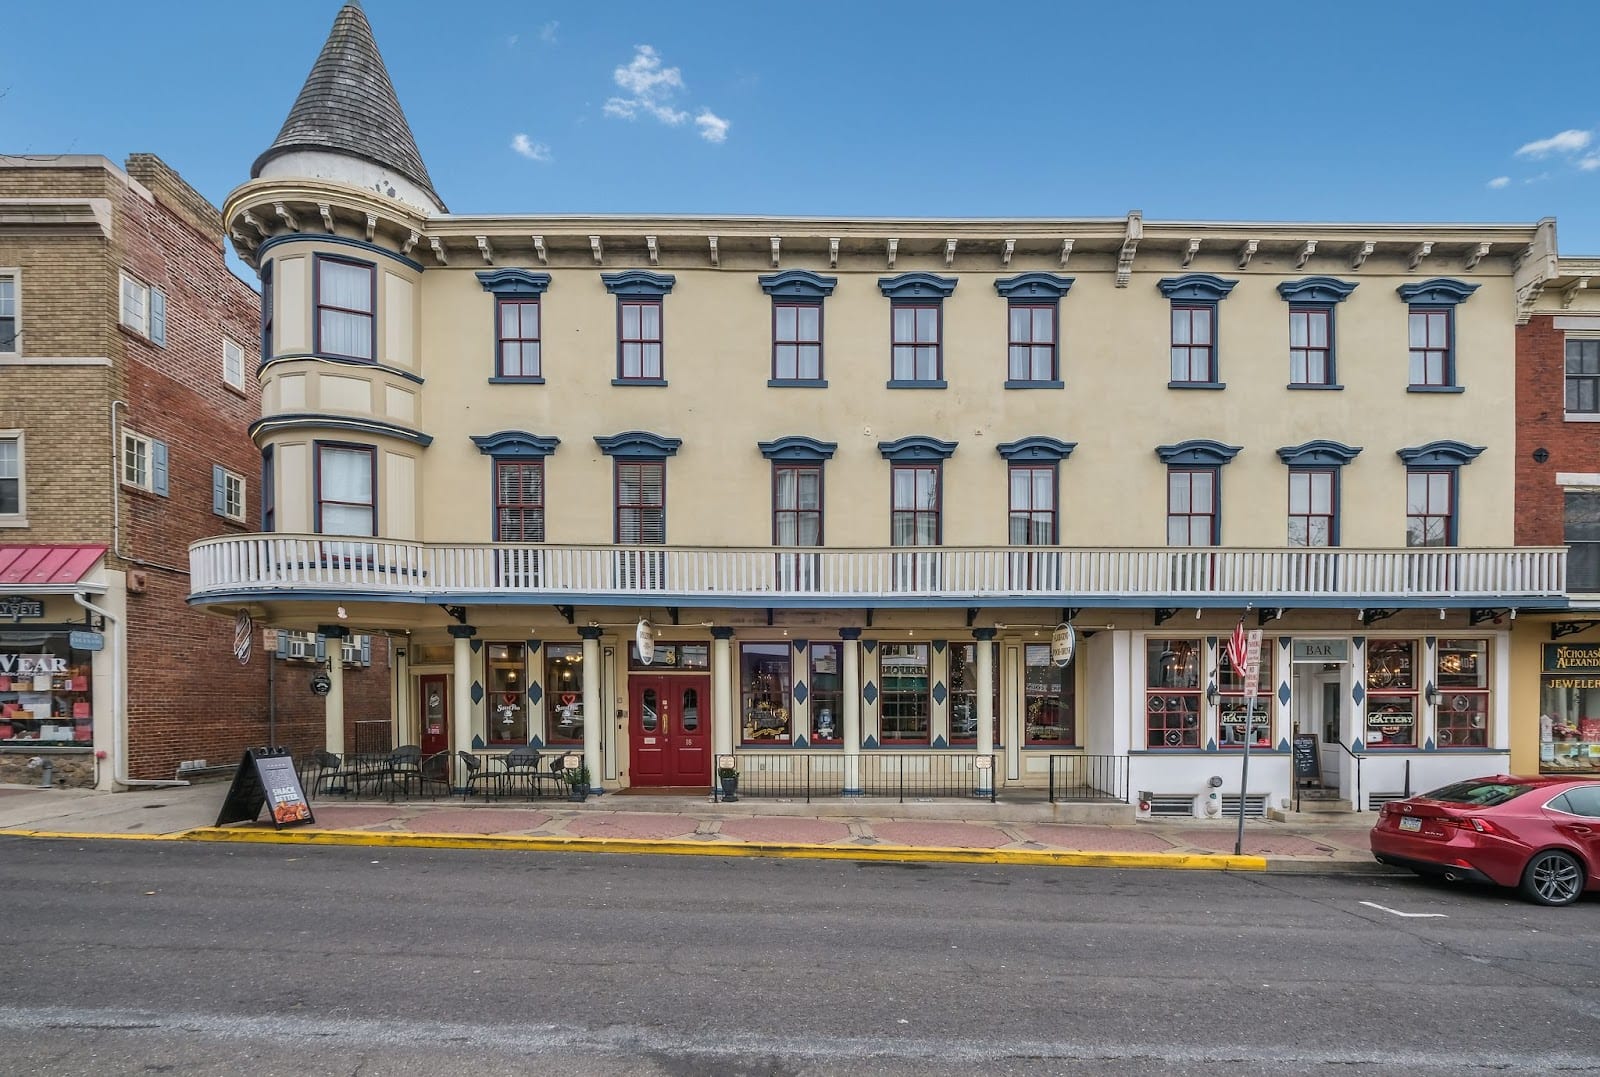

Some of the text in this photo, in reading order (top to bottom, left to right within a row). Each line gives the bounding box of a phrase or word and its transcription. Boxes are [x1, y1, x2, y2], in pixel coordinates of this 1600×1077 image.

[21, 604, 41, 614] EYE
[1306, 645, 1333, 656] BAR
[1556, 646, 1598, 658] NICHOLAS
[1555, 657, 1600, 669] ALEXAND
[1369, 714, 1413, 724] HATTERY
